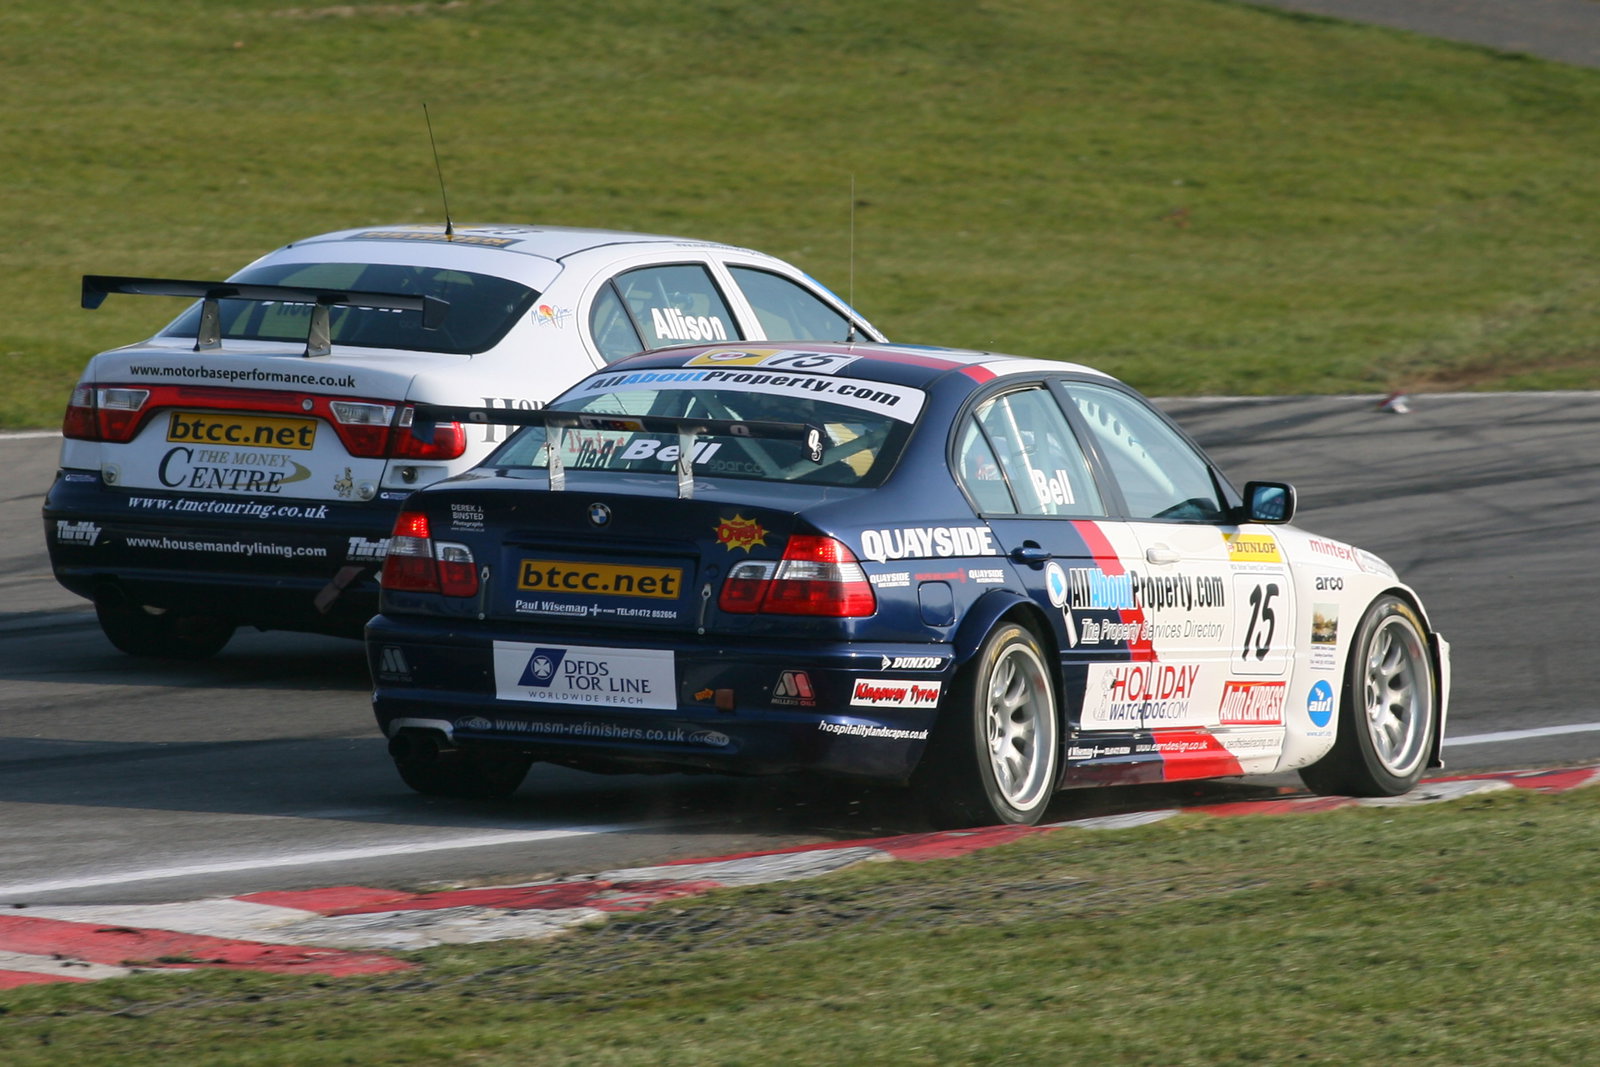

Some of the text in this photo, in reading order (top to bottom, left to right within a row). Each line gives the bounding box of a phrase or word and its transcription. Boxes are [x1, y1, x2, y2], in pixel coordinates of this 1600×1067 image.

[652, 308, 727, 341] Allison
[130, 365, 356, 388] www.motorbaseperformance.co.uk
[586, 366, 901, 407] AllAboutProperty.com
[170, 415, 313, 446] btcc.net
[199, 450, 291, 468] THE MONEY
[620, 439, 722, 464] Bell
[158, 446, 284, 494] CENTRE
[1031, 469, 1075, 505] Bell
[128, 496, 328, 519] www.tmctouring.co.uk
[57, 520, 102, 546] Thrifty
[861, 526, 997, 563] QUAYSIDE
[126, 537, 327, 557] www.housemandrylining.com
[1235, 542, 1276, 553] DUNLOP
[1309, 539, 1353, 561] mintex
[522, 563, 676, 596] btcc.net
[870, 572, 910, 583] QUAYSIDE
[968, 569, 1005, 578] QUAYSIDE
[1315, 576, 1344, 590] arco
[1072, 569, 1225, 611] AllAboutProperty.com
[515, 600, 538, 610] Paul
[541, 601, 588, 616] Wiseman
[1081, 619, 1225, 645] The Property Services Directory
[1242, 583, 1279, 662] 15
[564, 660, 609, 676] DFDS
[891, 657, 942, 669] DUNLOP
[564, 675, 652, 694] TOR LINE
[854, 682, 939, 704] Kingsway Tyres
[1111, 664, 1200, 702] HOLIDAY
[528, 691, 644, 705] WORLDWIDE REACH
[1221, 685, 1285, 720] Auto EXPRESS
[1109, 701, 1189, 721] WATCHDOG.COM
[495, 718, 685, 743] www.msm-refinishers.co.uk
[818, 720, 929, 740] hospitalitylandscapes.co.uk
